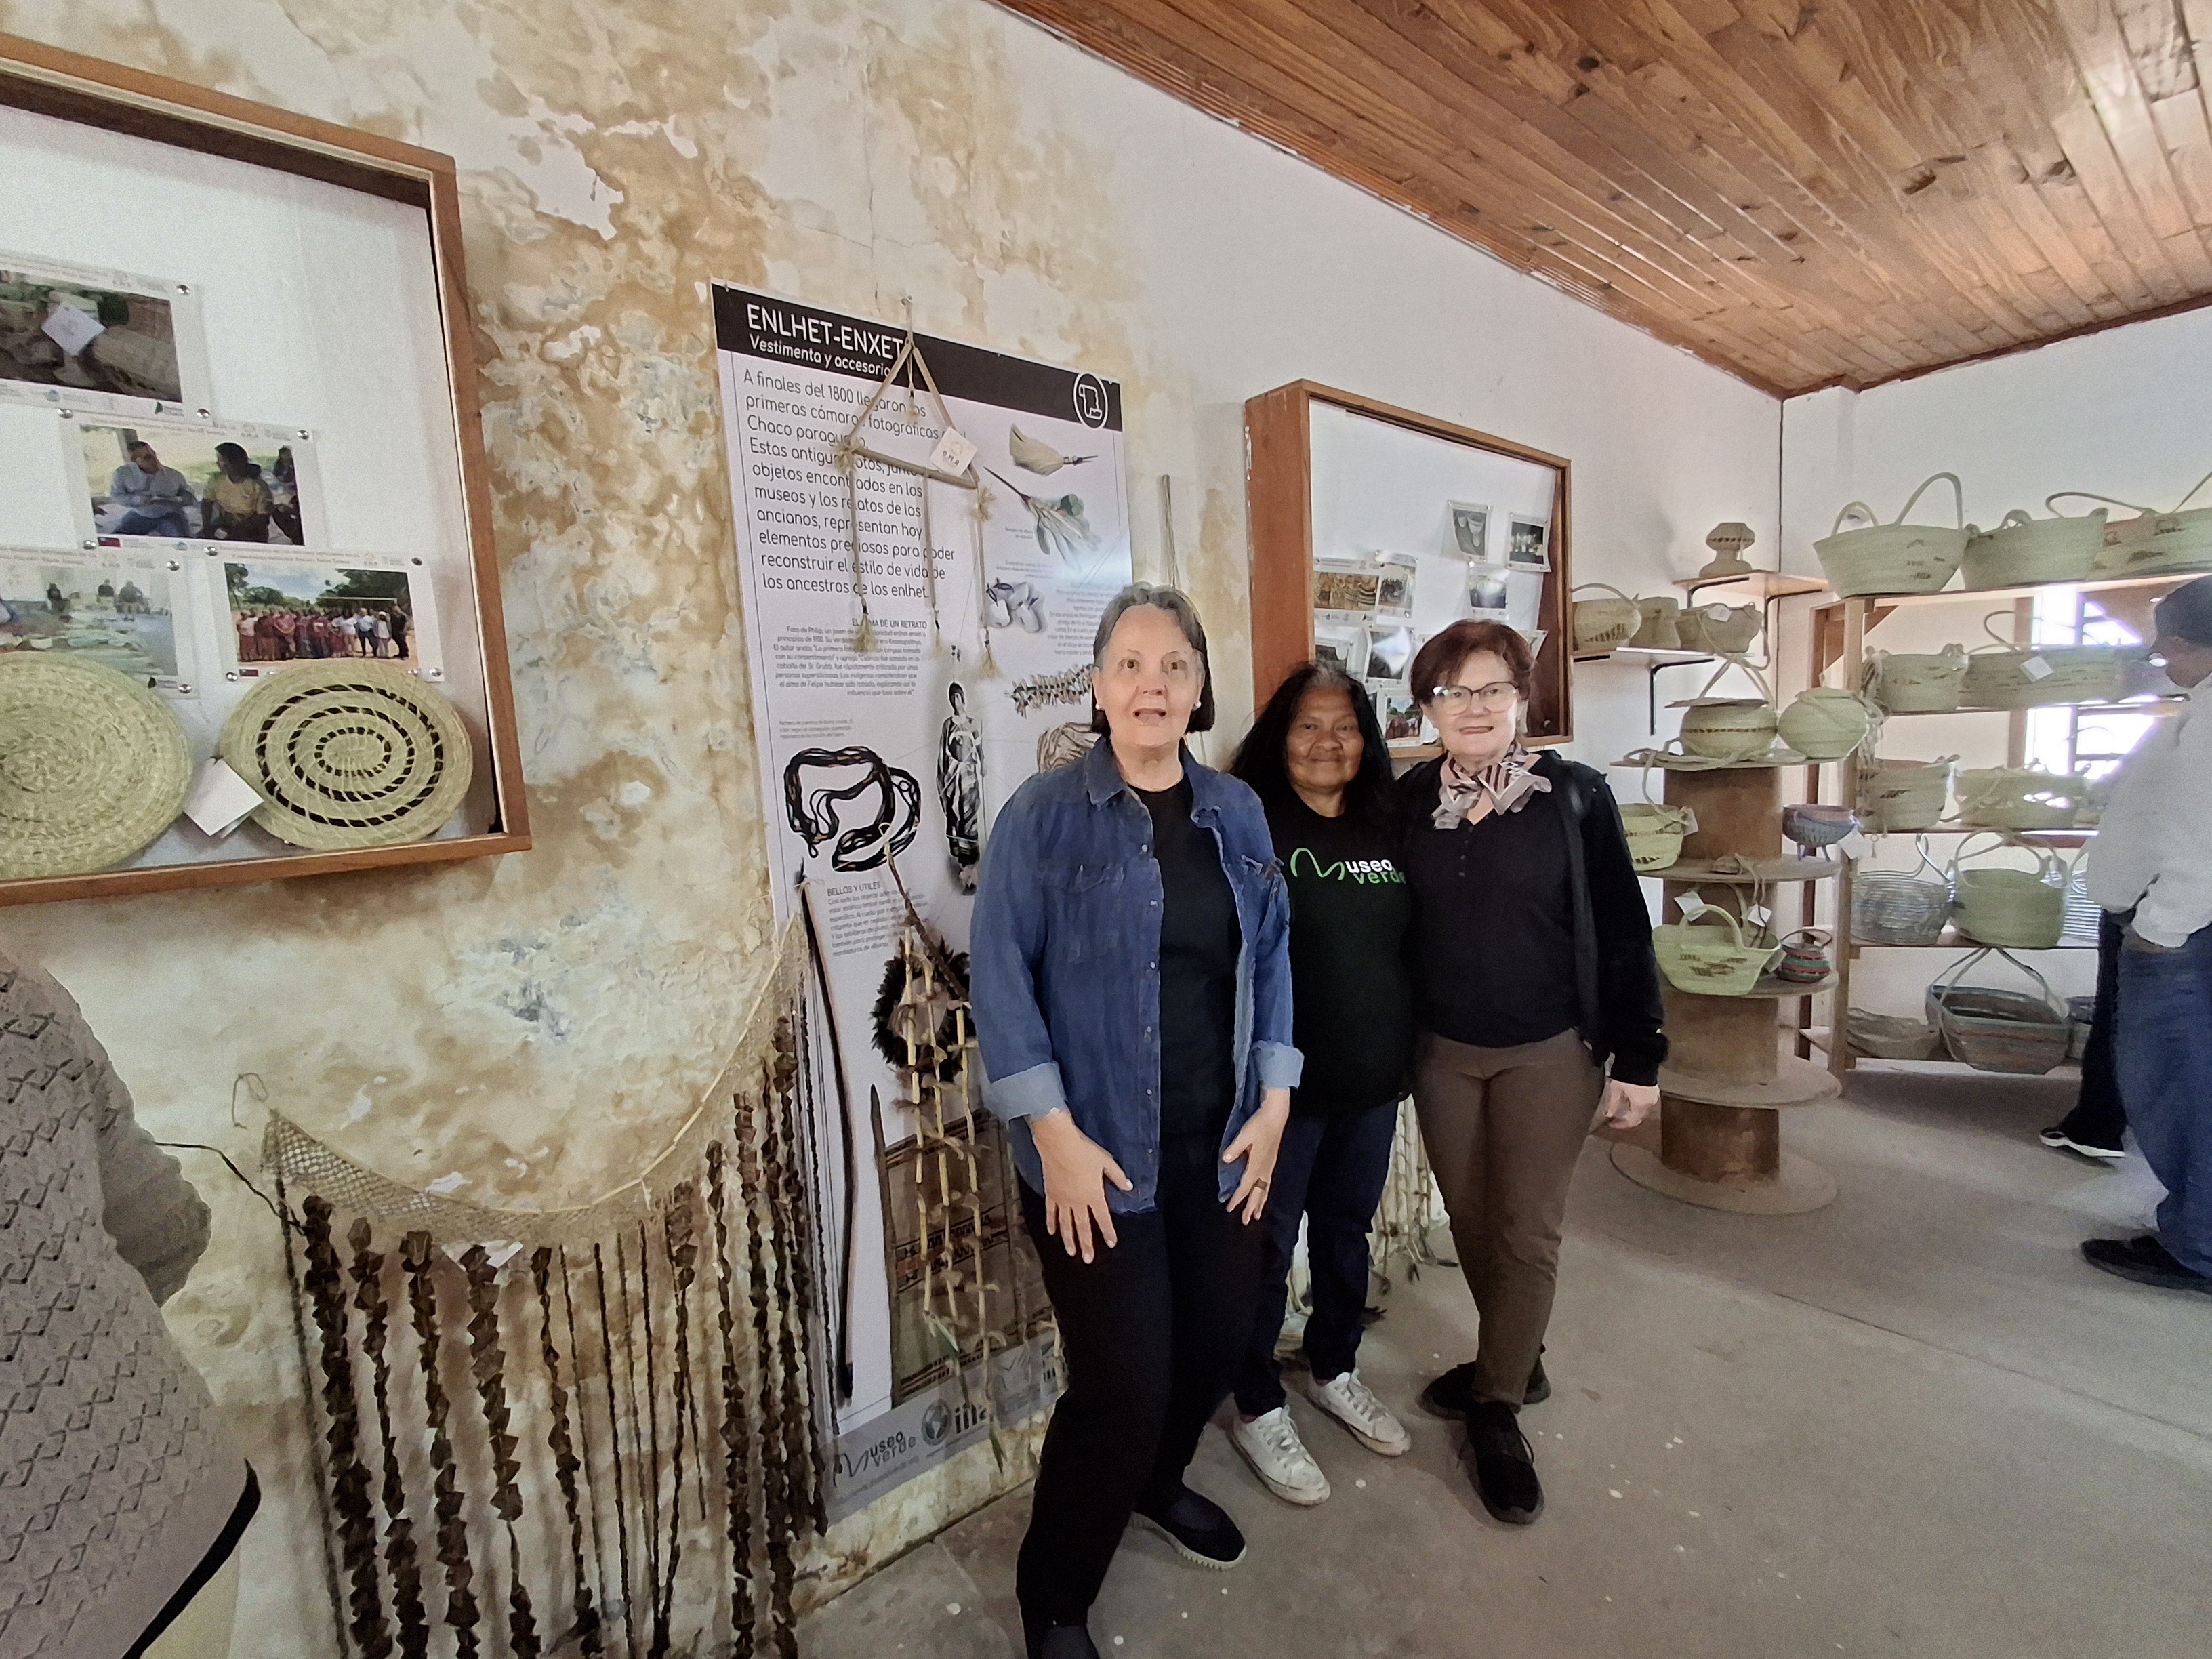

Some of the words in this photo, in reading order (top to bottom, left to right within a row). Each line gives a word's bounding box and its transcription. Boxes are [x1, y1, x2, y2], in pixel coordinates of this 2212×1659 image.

[747, 303, 903, 359] ENLHET-ENXET
[749, 333, 821, 364] Vestimenta
[824, 354, 832, 369] y
[835, 355, 891, 377] accesorio
[743, 369, 754, 384] A
[757, 371, 801, 394] finales
[804, 383, 825, 398] del
[827, 385, 854, 404] 1800
[746, 395, 806, 417] primeras
[811, 405, 865, 426] cámara
[747, 415, 792, 436] Chaco
[750, 437, 788, 456] Estas
[855, 457, 884, 474] otos,
[752, 462, 802, 482] objetos
[806, 471, 886, 493] encontados
[888, 483, 903, 495] en
[905, 482, 922, 497] los
[755, 486, 806, 505] museos
[809, 494, 816, 508] y
[819, 491, 838, 508] los
[842, 497, 884, 513] reatos
[886, 500, 901, 515] de
[904, 502, 922, 518] los
[756, 509, 821, 529] ancianos,
[824, 517, 899, 535] reprsentan
[901, 522, 922, 541] hoy
[759, 529, 827, 550] elementos
[893, 546, 920, 558] para
[762, 554, 834, 571] reconstruir
[838, 558, 848, 573] el
[852, 559, 883, 575] estilo
[887, 562, 901, 575] de
[904, 564, 928, 579] vida
[762, 573, 783, 589] los
[786, 577, 849, 594] ancestros
[871, 582, 888, 596] los
[880, 619, 888, 628] DE
[890, 620, 900, 628] UN
[901, 620, 928, 629] RETRATO
[827, 886, 853, 897] BELLOS
